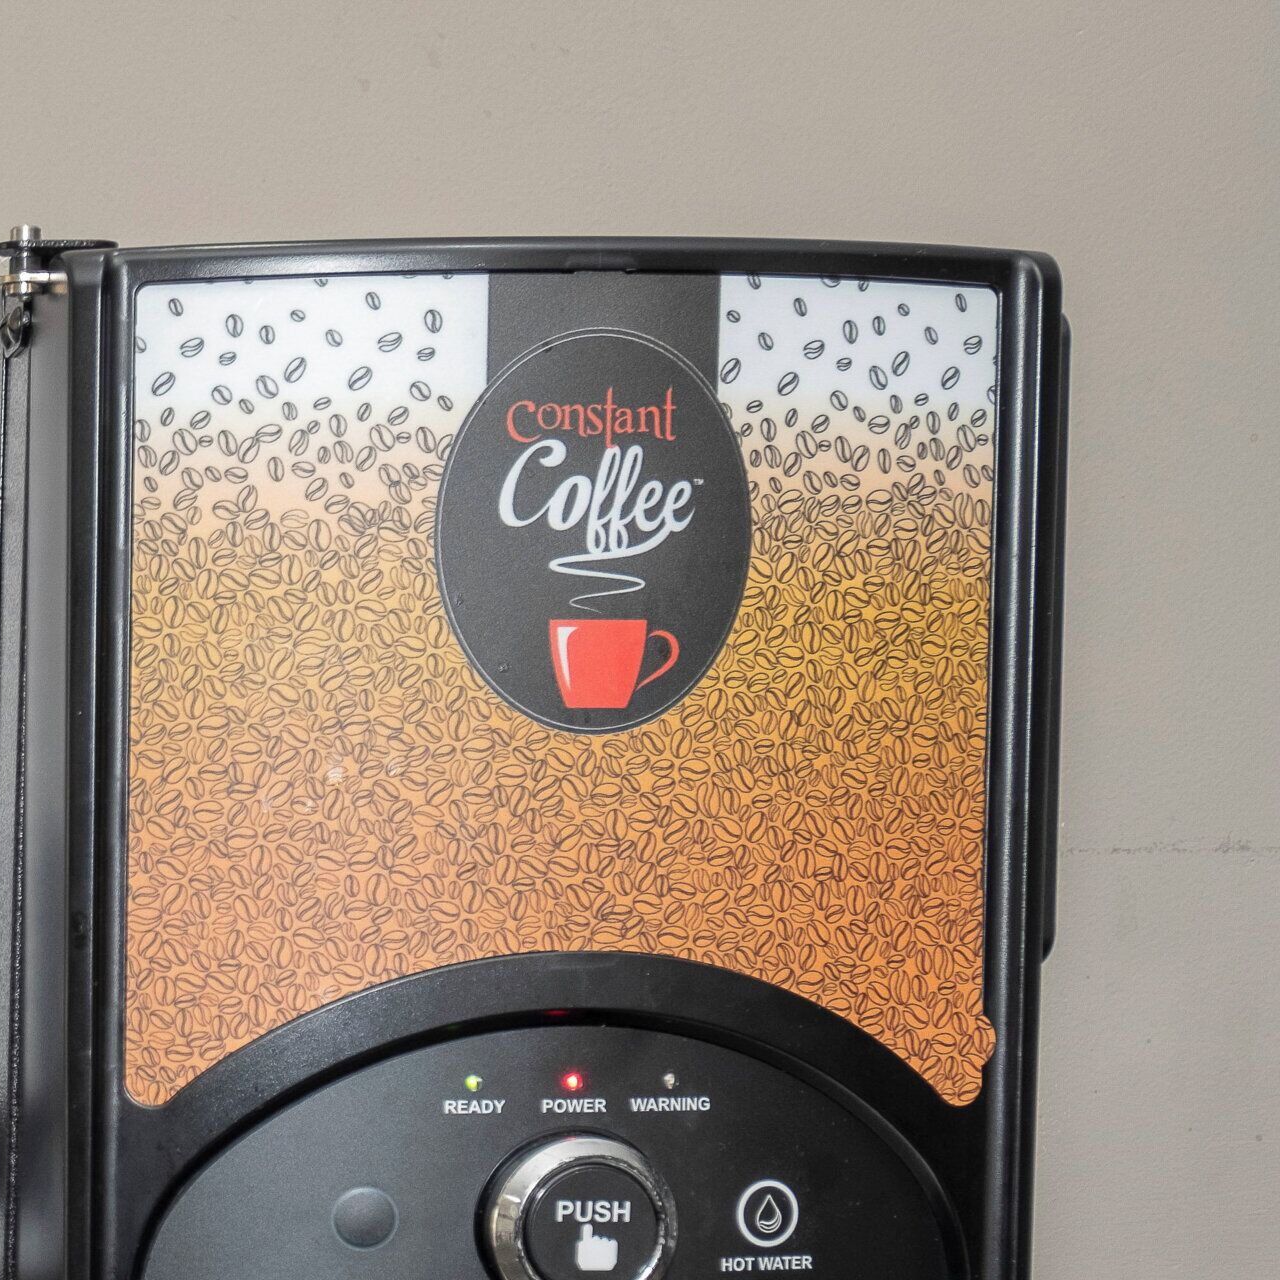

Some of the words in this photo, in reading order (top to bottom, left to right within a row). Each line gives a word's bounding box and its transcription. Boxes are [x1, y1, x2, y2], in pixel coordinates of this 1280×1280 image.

[506, 385, 677, 449] constant
[499, 438, 696, 554] Coffee
[443, 1099, 506, 1115] READY
[541, 1098, 607, 1114] POWER
[631, 1096, 711, 1112] WARNING
[556, 1200, 632, 1223] PUSH
[721, 1257, 756, 1272] HOT
[758, 1255, 813, 1271] WATER
